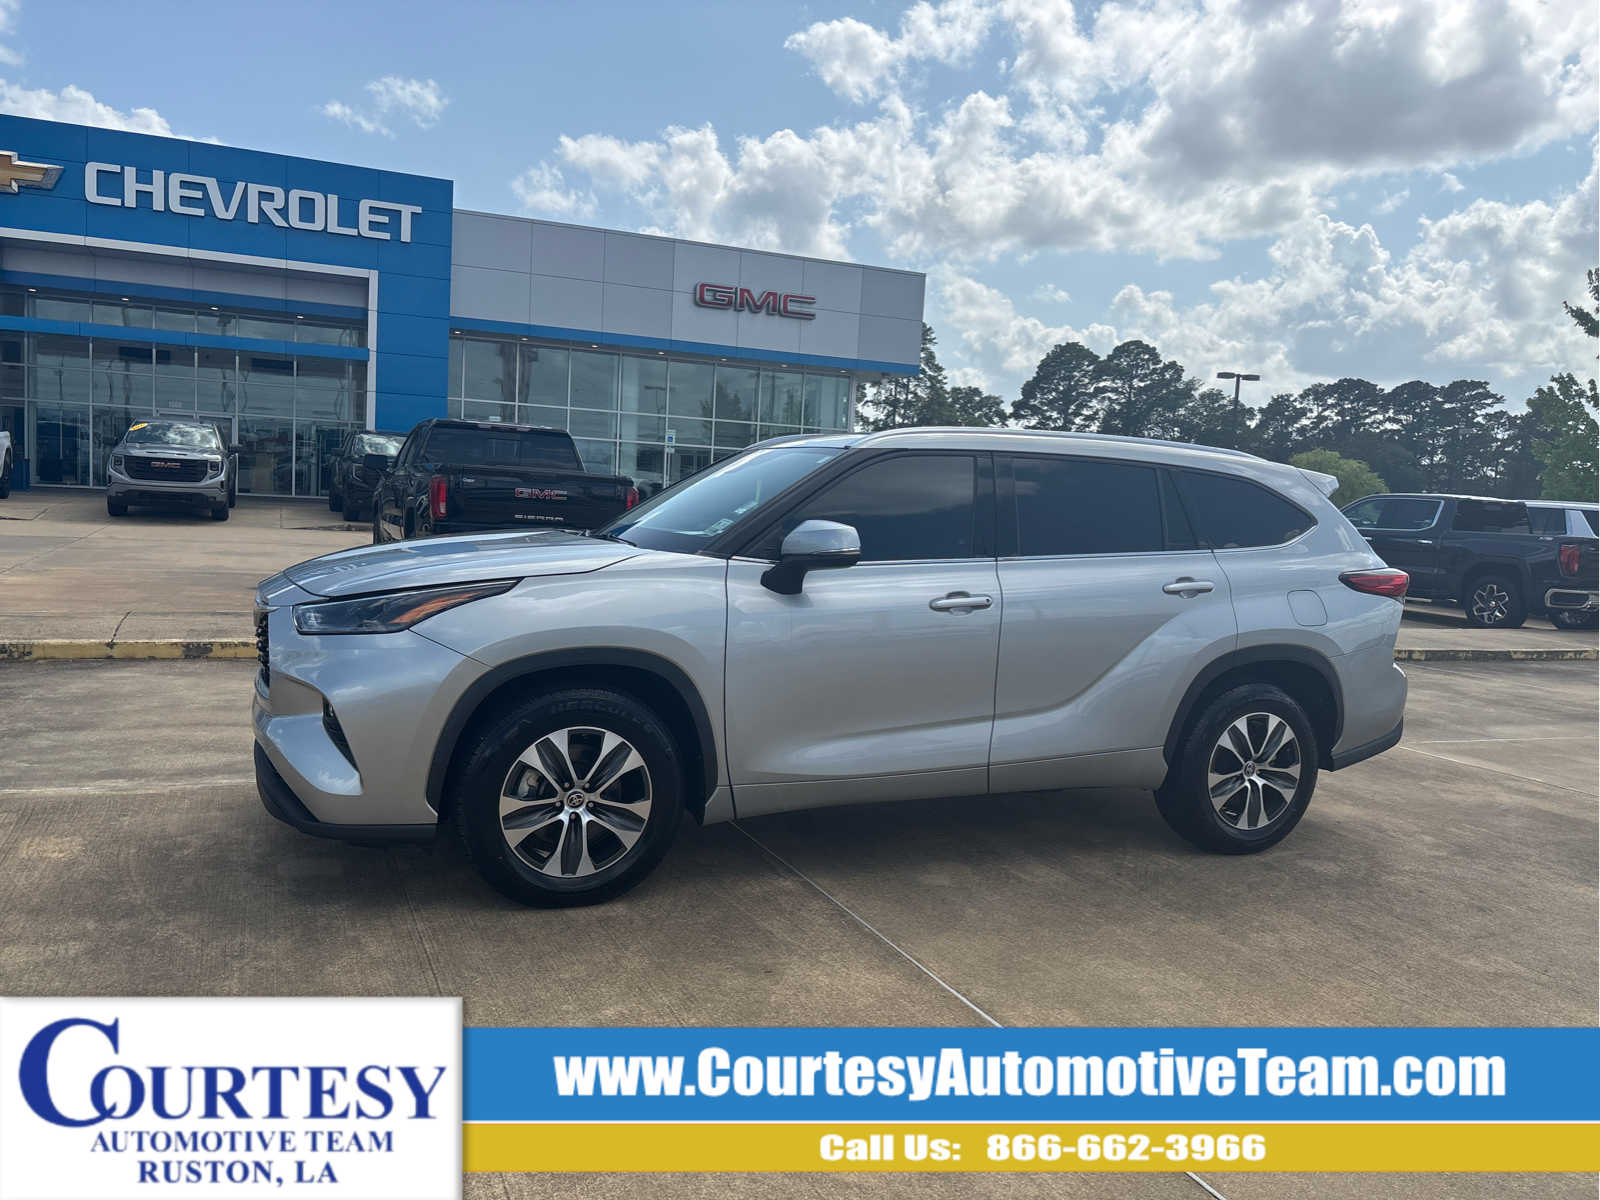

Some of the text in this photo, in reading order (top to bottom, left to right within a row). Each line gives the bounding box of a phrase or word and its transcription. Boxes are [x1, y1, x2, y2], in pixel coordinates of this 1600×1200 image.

[84, 161, 422, 243] CHEVROLET
[695, 280, 816, 321] GMC
[514, 487, 568, 501] GMC
